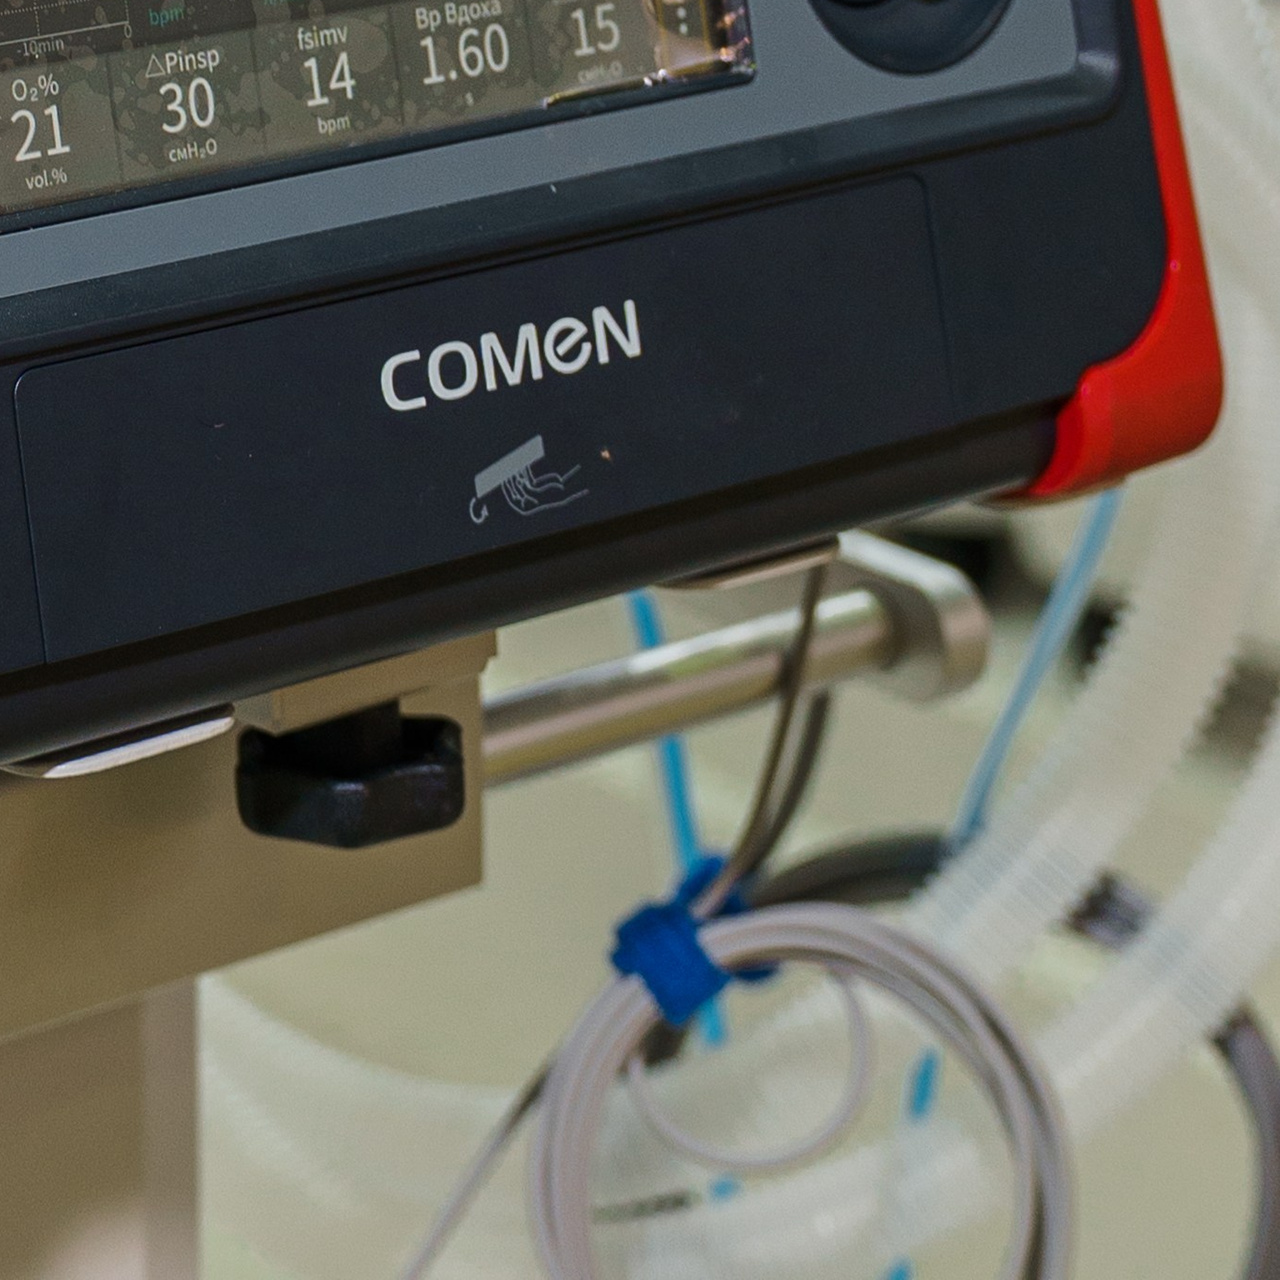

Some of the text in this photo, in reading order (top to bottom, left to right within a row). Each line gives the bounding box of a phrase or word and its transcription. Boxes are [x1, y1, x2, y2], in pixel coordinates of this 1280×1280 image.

[298, 24, 348, 51] fsimv
[421, 23, 510, 85] 1.60
[570, 3, 621, 57] 15
[160, 77, 215, 134] 30
[304, 52, 356, 107] 14
[11, 104, 70, 162] 21
